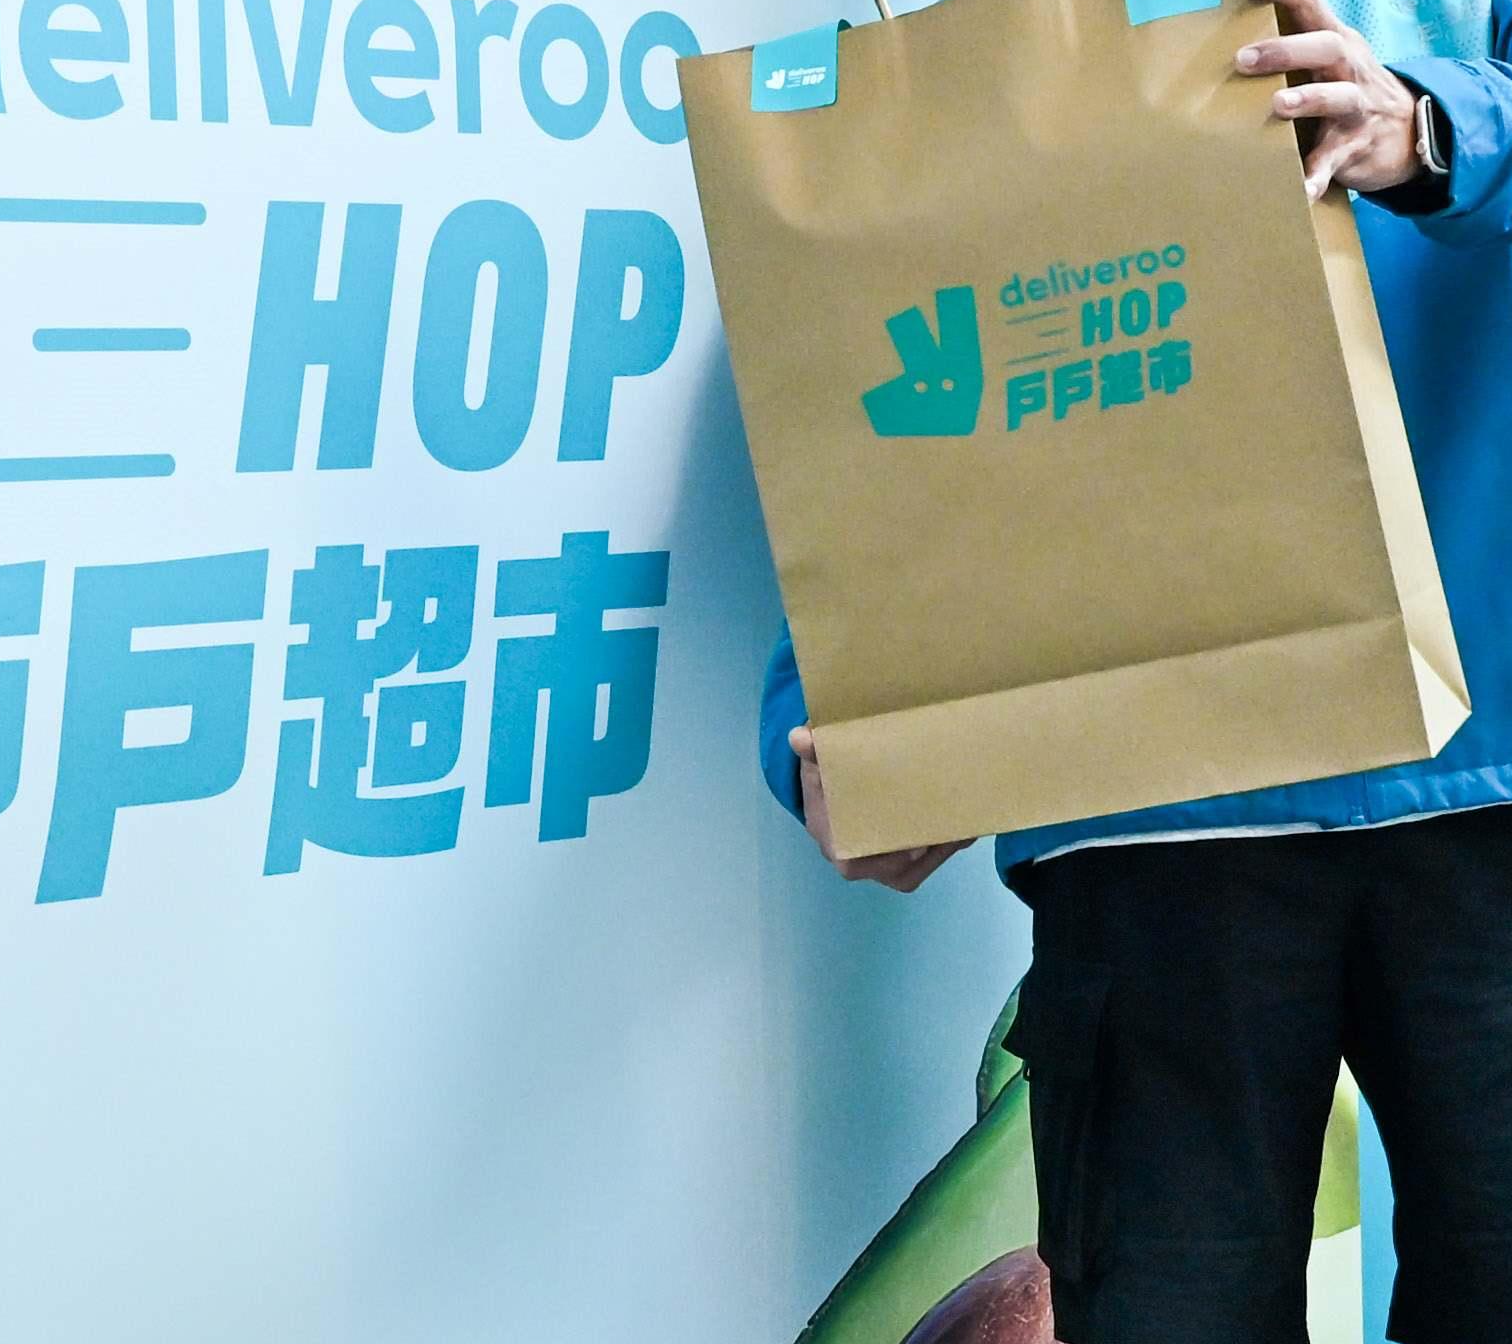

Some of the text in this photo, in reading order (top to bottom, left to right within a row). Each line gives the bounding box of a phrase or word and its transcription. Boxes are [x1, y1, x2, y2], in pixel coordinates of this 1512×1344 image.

[1000, 243, 1187, 308] deliveroo
[235, 199, 685, 473] HOP
[1081, 281, 1187, 348] HOP
